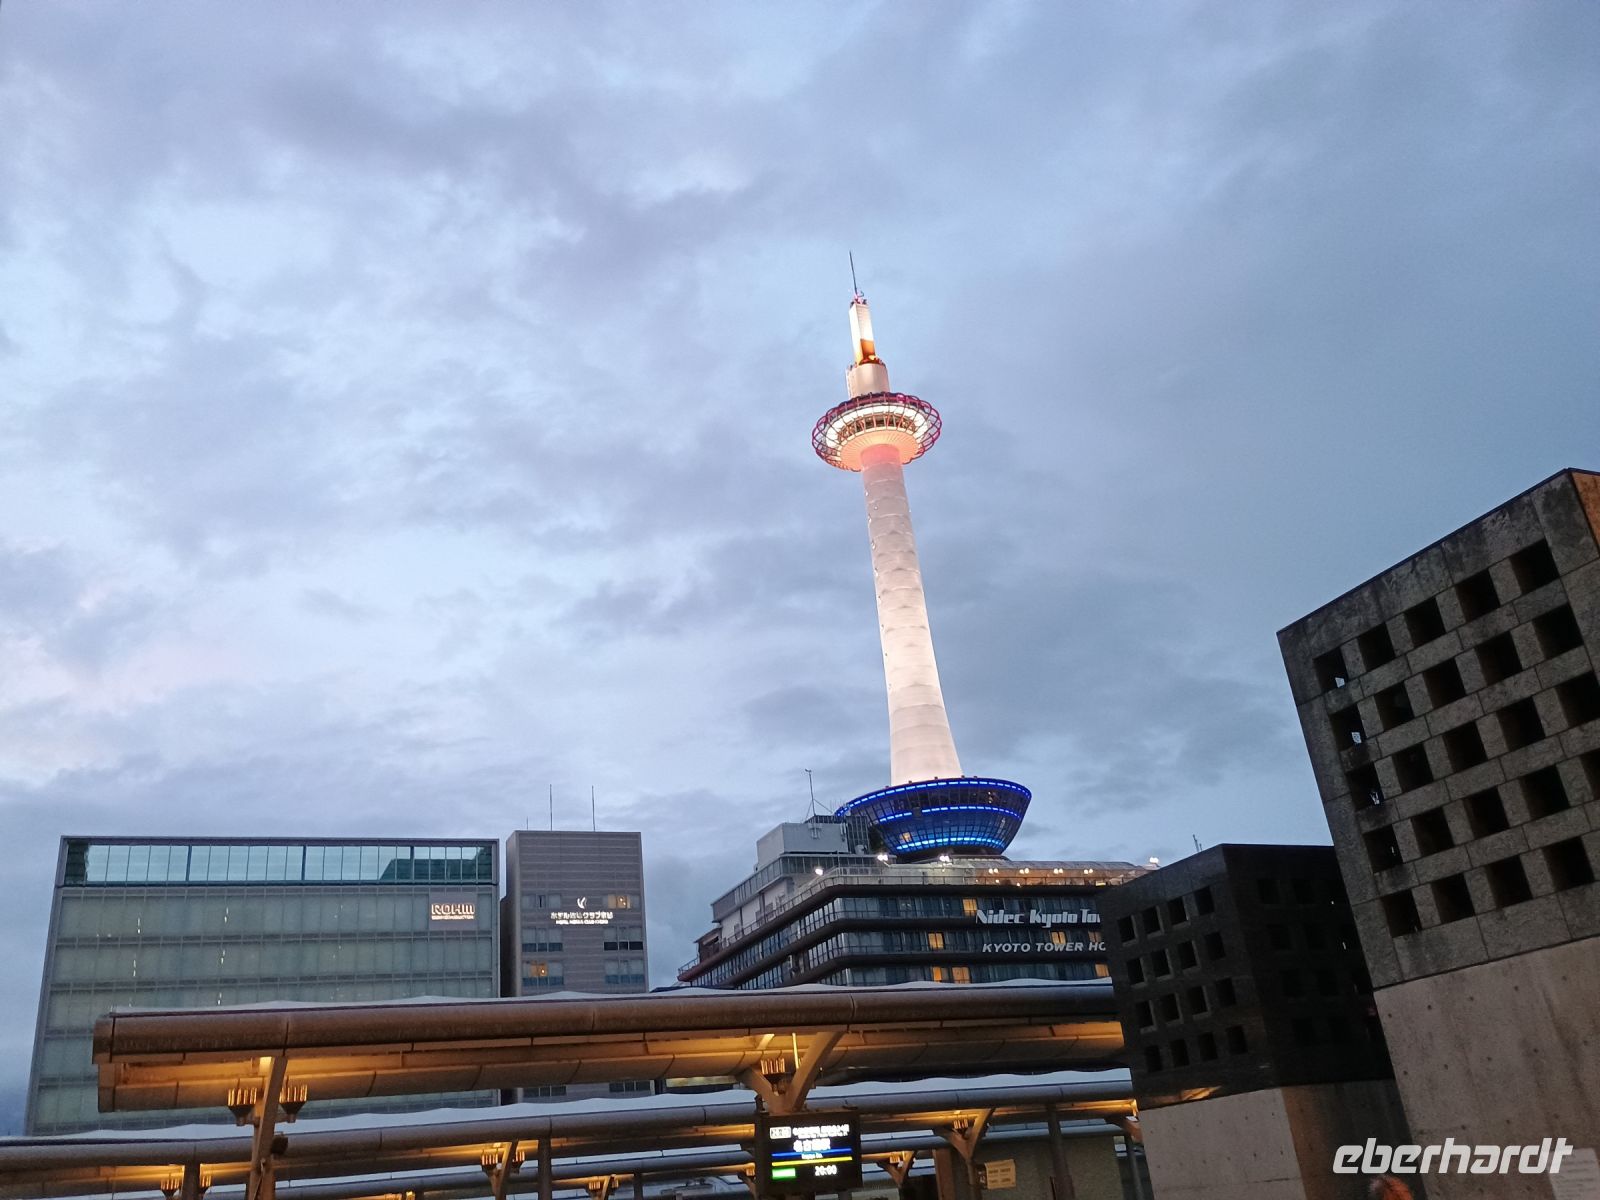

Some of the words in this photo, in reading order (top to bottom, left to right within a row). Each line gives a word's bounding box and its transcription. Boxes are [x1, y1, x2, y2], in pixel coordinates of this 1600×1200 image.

[431, 903, 475, 915] ROHM
[975, 909, 1025, 924] Nidec
[1029, 908, 1078, 928] Kyoto
[982, 942, 1031, 953] KYOTO
[1035, 942, 1084, 952] TOWER
